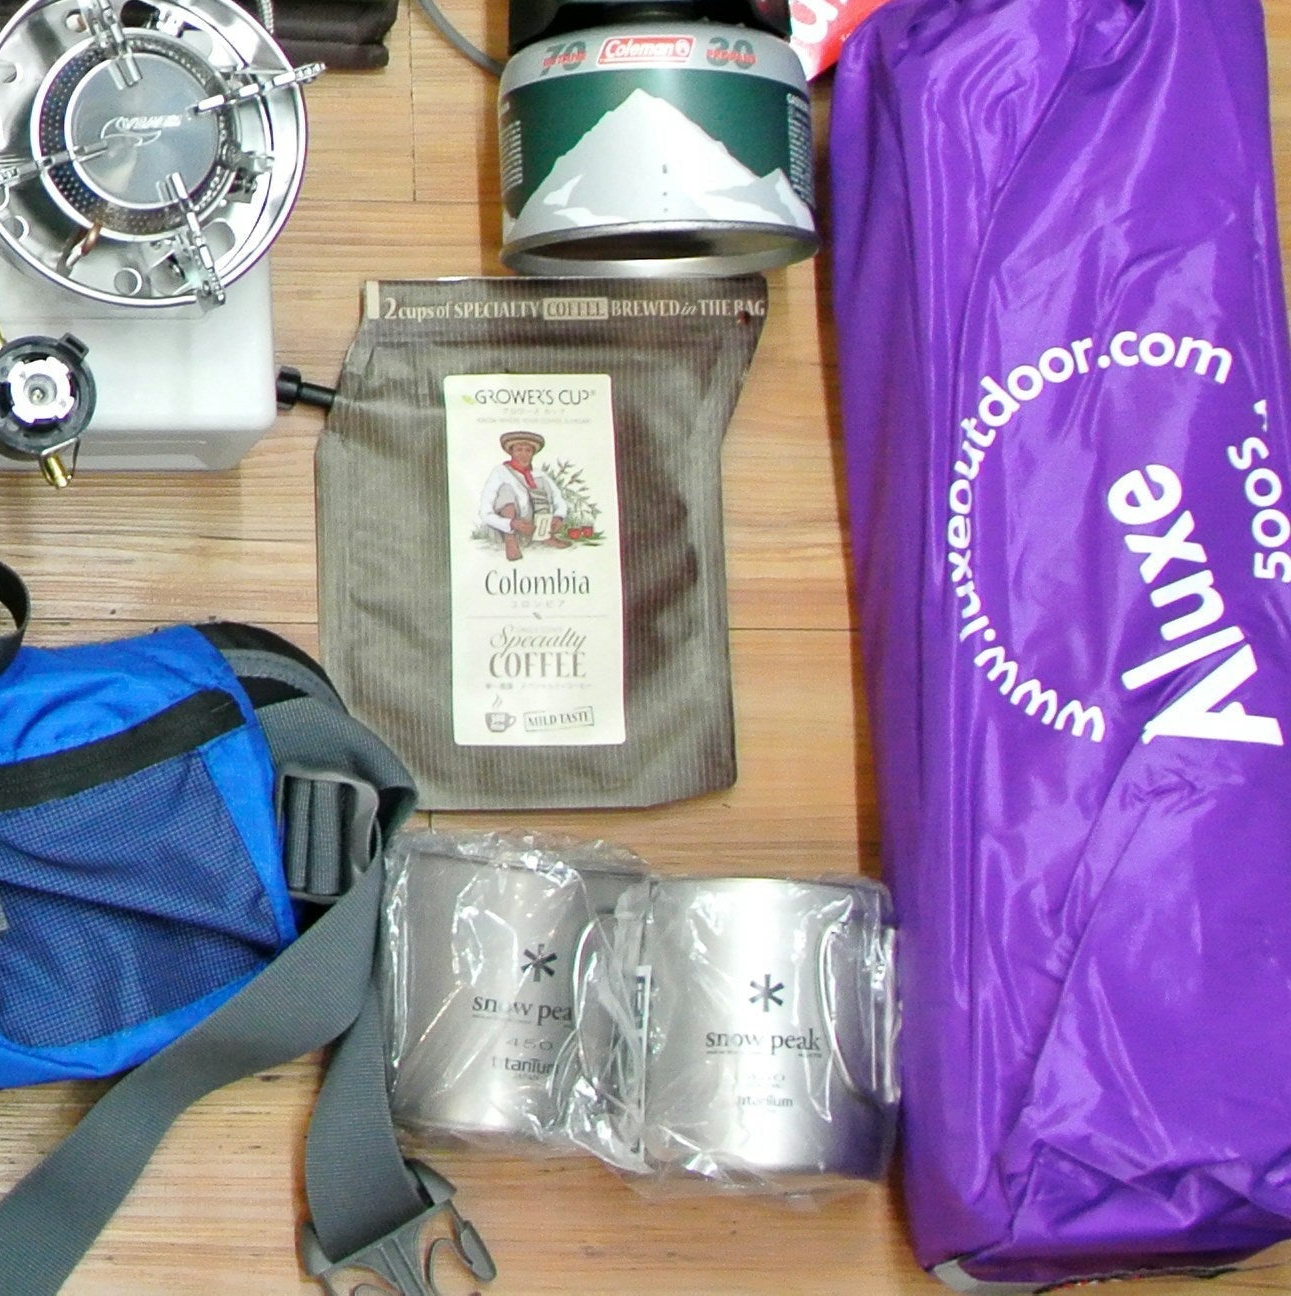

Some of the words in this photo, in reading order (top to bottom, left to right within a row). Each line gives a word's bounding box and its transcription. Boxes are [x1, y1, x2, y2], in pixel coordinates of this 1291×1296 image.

[541, 40, 587, 77] 70
[604, 39, 676, 59] Coleman
[707, 36, 754, 70] 30
[384, 297, 397, 320] 2
[398, 306, 435, 323] cups
[436, 301, 451, 319] of
[454, 301, 540, 319] SPECIALTY
[546, 301, 606, 318] COFFEE
[611, 299, 680, 317] BREWED
[681, 301, 698, 316] in
[697, 299, 732, 316] THE
[734, 299, 766, 317] BAG
[474, 388, 554, 405] GROWER'S
[558, 388, 590, 405] CUP
[485, 568, 591, 595] Colombia
[489, 623, 588, 659] Specialty
[489, 651, 587, 679] COFFEE
[472, 995, 533, 1016] snw
[771, 1028, 821, 1056] peak
